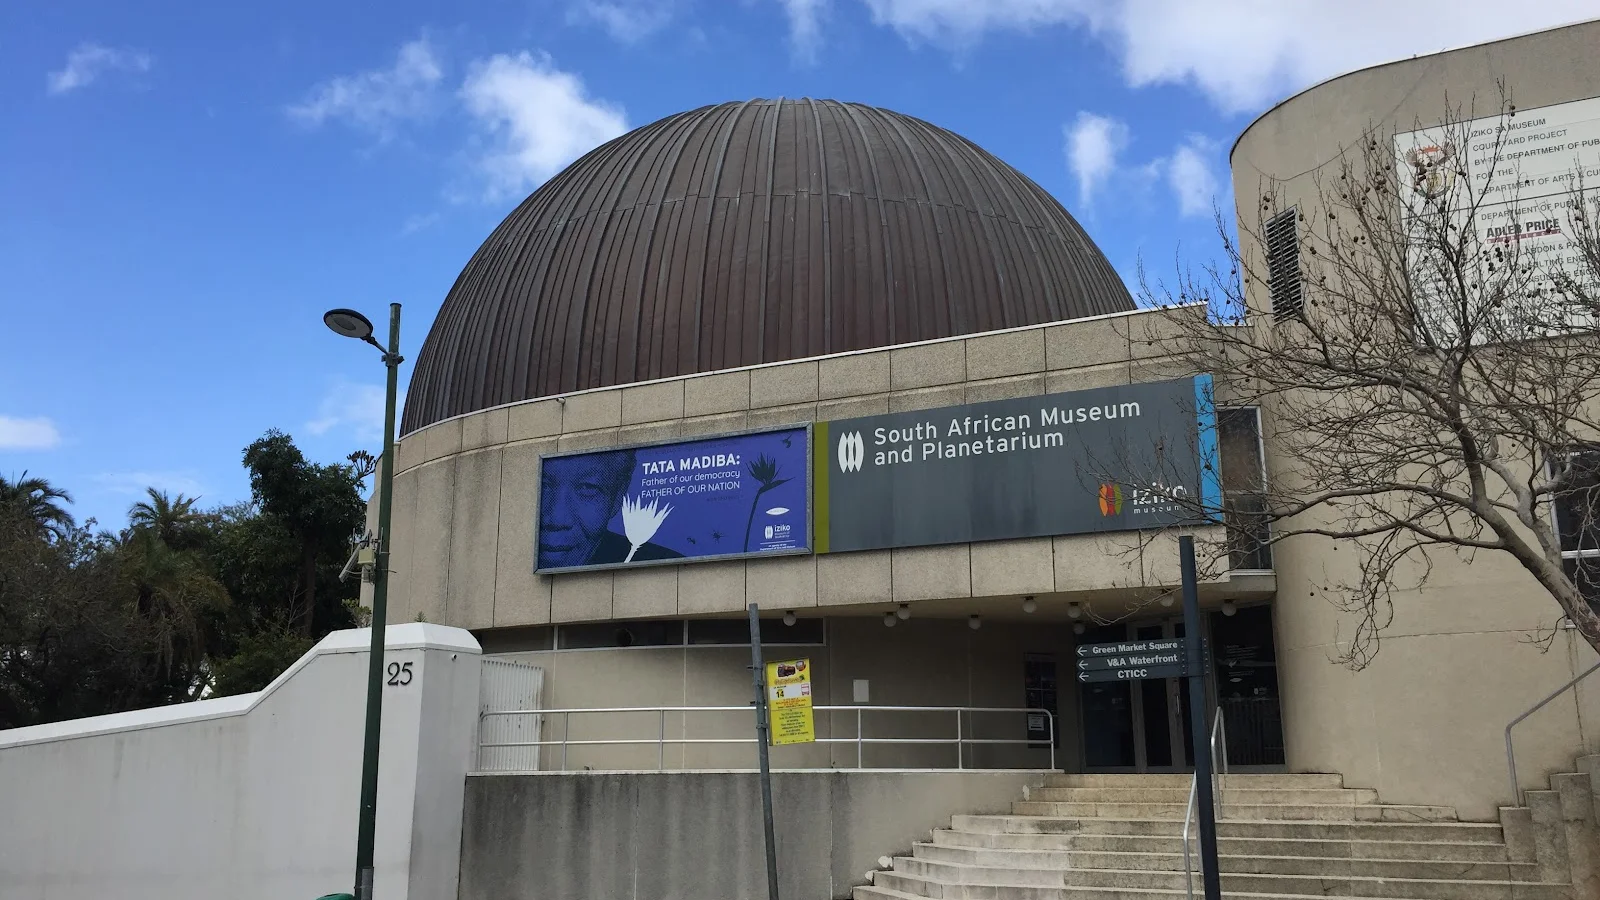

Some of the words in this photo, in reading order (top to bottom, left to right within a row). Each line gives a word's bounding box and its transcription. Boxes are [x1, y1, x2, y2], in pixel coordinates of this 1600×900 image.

[1509, 119, 1546, 130] MUSEUM
[1528, 129, 1567, 141] PROJECT
[1474, 158, 1486, 166] BY
[1507, 144, 1565, 160] DEPARTMENT
[1567, 142, 1579, 150] OF
[1476, 171, 1494, 180] FOR
[1496, 167, 1514, 177] THE
[1537, 177, 1550, 186] OF
[1552, 173, 1576, 184] ARTS
[1540, 203, 1552, 212] OF
[1525, 218, 1560, 232] PRICE
[873, 421, 938, 446] South
[947, 413, 1031, 438] African
[1040, 401, 1141, 428] Museum
[873, 445, 913, 467] and
[921, 431, 1064, 462] Planetarium
[642, 460, 676, 475] TATA
[680, 453, 741, 471] MADIBA:
[641, 477, 667, 487] Father
[668, 474, 679, 484] of
[679, 474, 693, 483] our
[694, 470, 741, 482] democracy
[641, 487, 673, 498] FATHER
[673, 485, 686, 496] OF
[687, 483, 707, 494] OUR
[708, 480, 741, 492] NATION
[1132, 504, 1190, 515] museum
[1092, 646, 1117, 654] Green
[1118, 643, 1147, 652] Market
[1148, 641, 1178, 651] Square
[1107, 658, 1127, 667] V&A
[1128, 654, 1178, 665] Waterfront
[387, 661, 414, 686] 25
[1117, 668, 1148, 679] CTICC
[776, 690, 784, 698] 14
